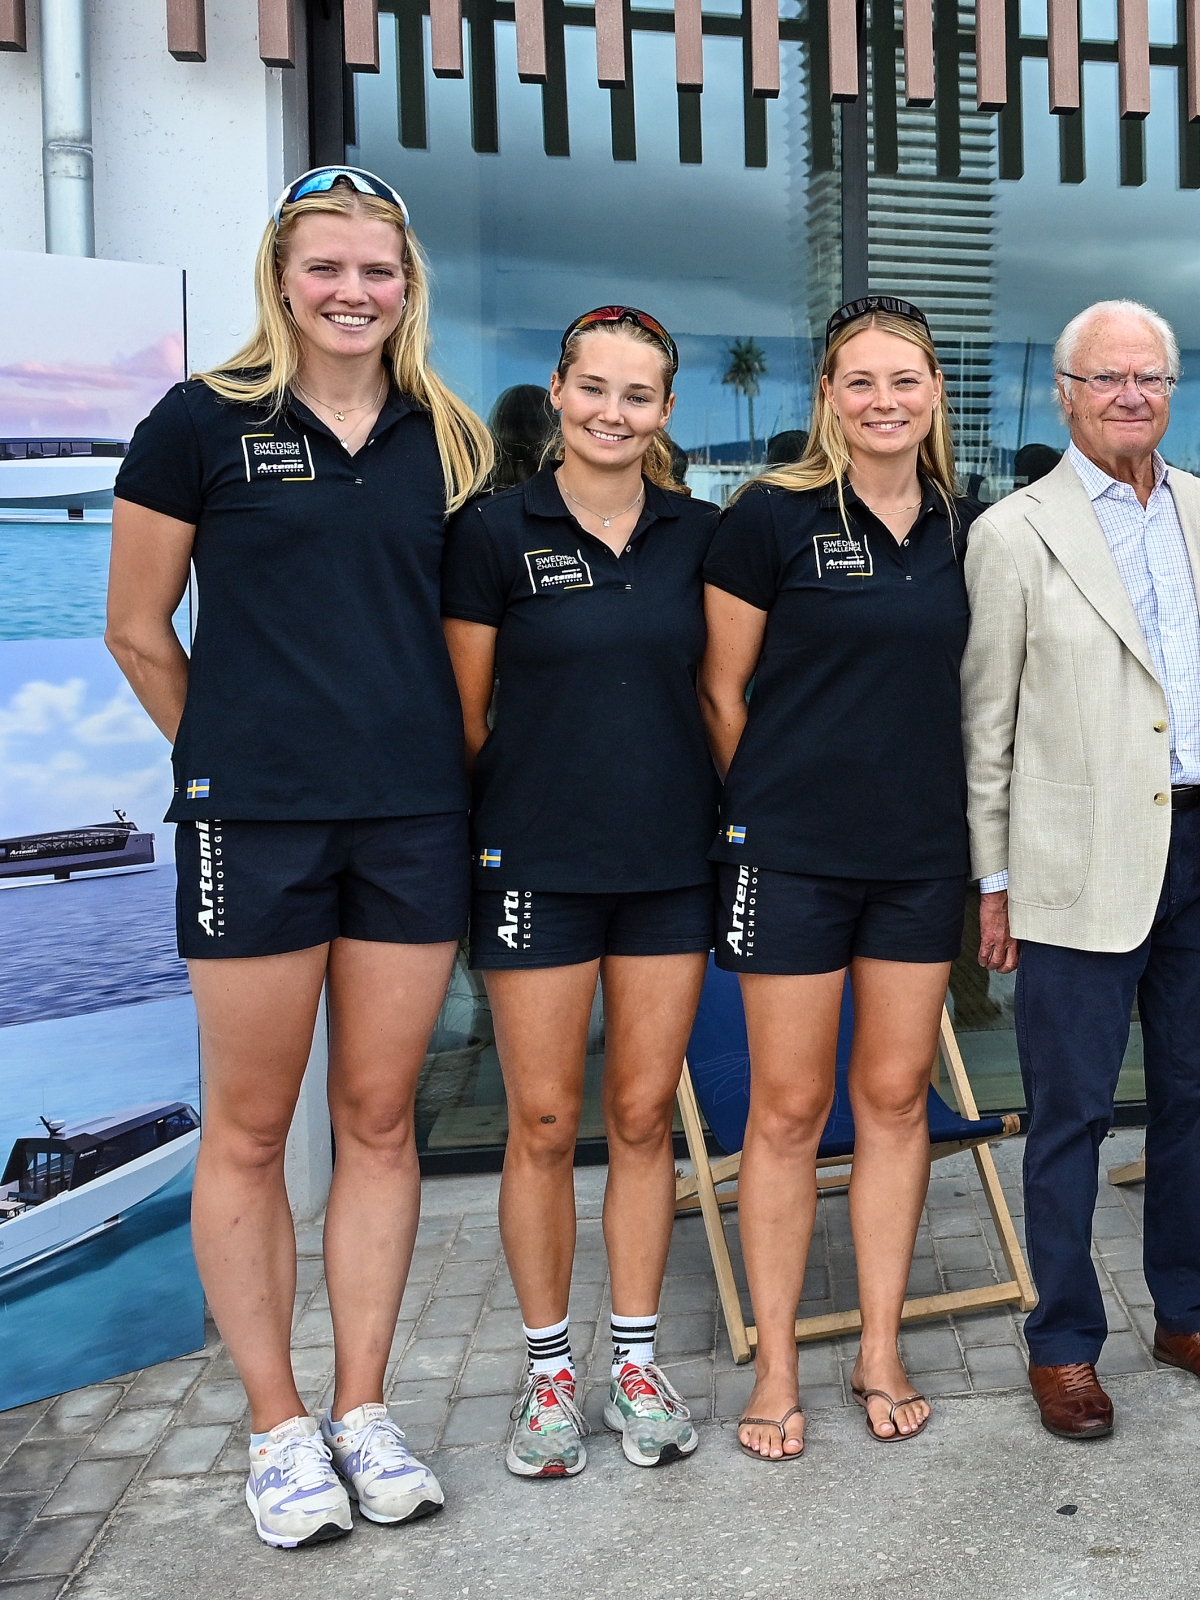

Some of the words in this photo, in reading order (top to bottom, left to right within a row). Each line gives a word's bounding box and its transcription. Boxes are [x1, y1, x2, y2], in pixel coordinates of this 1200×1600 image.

[253, 441, 300, 450] SWEDISH
[253, 448, 301, 456] CHALLENGE
[257, 462, 304, 471] Artemis
[823, 540, 861, 549] SWEDISH
[541, 572, 583, 584] Artemis
[195, 819, 215, 937] Artemi
[214, 819, 225, 938] TECHNOLOGI
[523, 890, 532, 950] TECHNO
